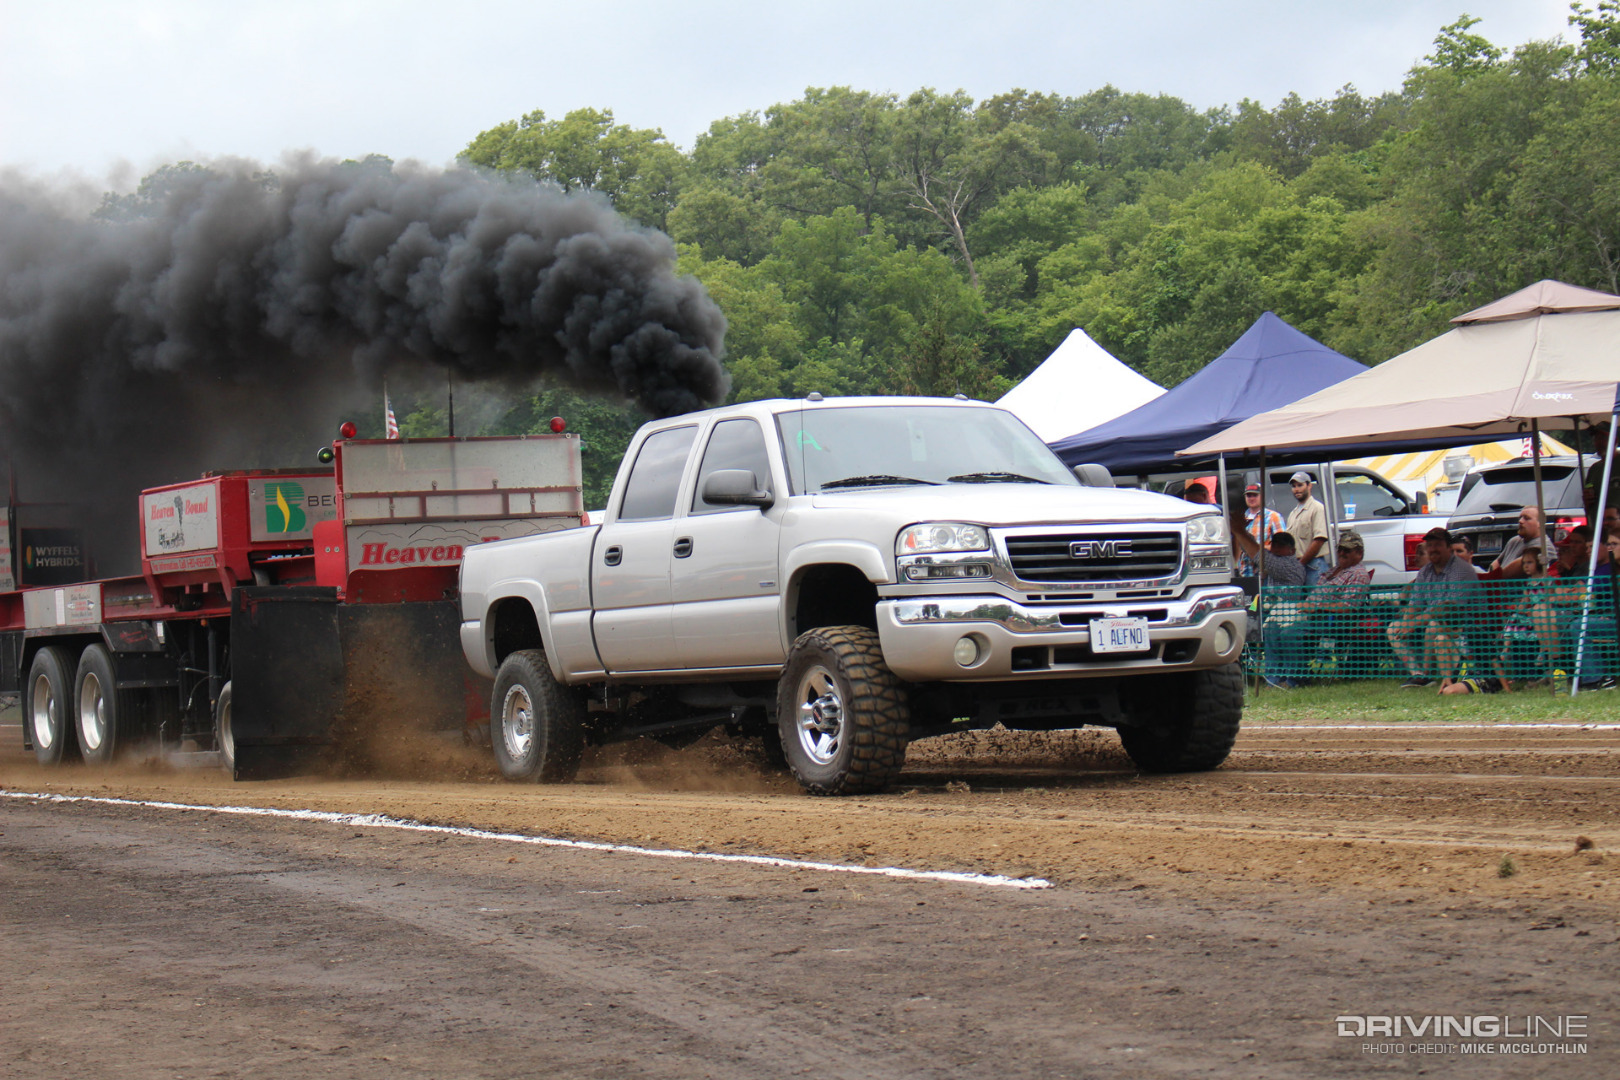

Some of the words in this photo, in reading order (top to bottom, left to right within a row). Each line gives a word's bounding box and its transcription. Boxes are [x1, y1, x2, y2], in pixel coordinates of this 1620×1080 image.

[151, 504, 175, 521] Heaven
[185, 496, 208, 515] Bound
[308, 495, 336, 507] BE
[359, 541, 464, 566] Heaven
[1069, 540, 1132, 558] GMC
[36, 557, 80, 567] HYBRIDS
